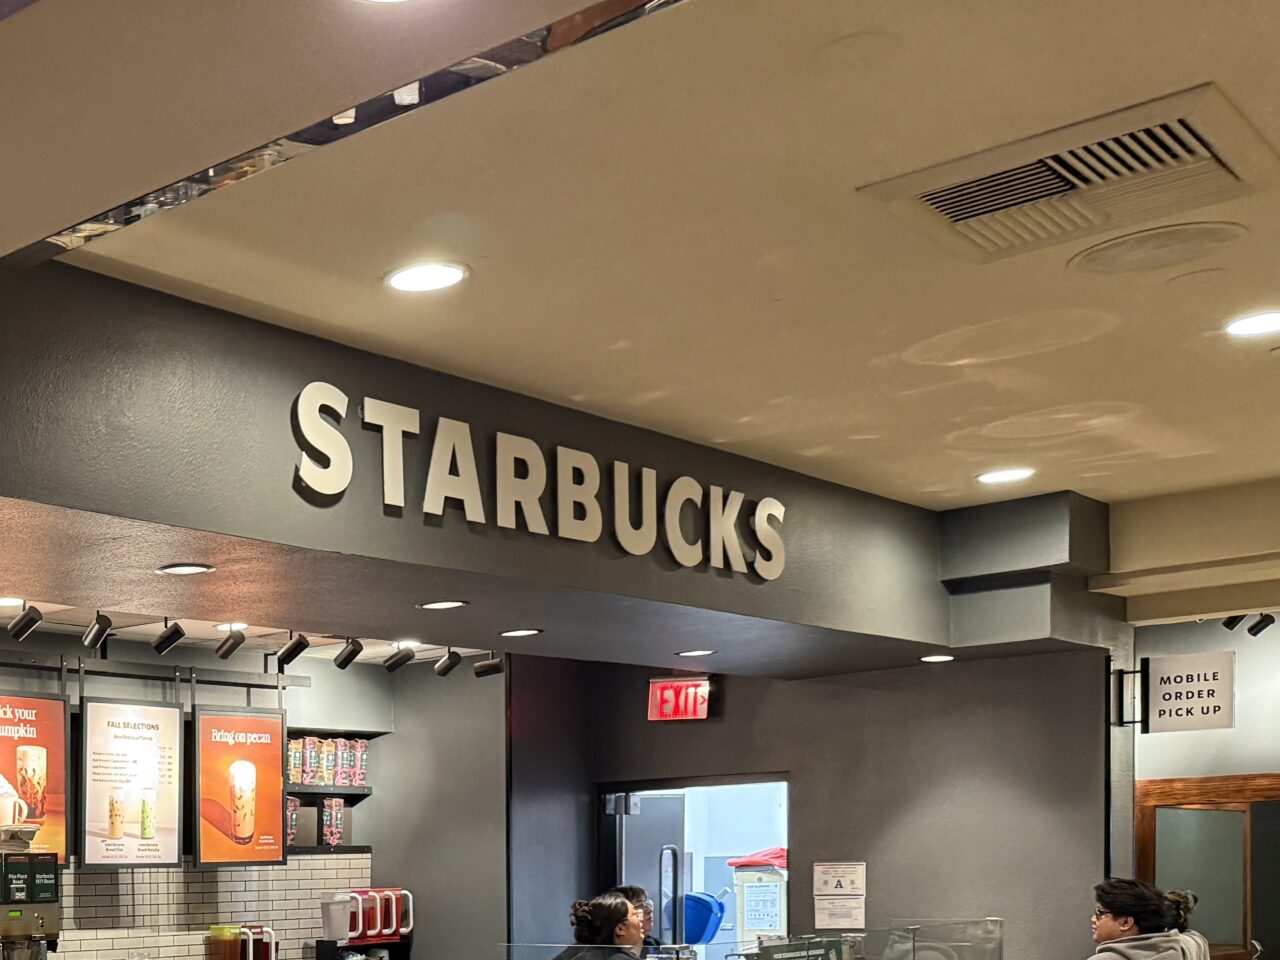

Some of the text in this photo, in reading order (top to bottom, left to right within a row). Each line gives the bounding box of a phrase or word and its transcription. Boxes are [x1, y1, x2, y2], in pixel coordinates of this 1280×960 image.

[296, 381, 786, 581] STARBUCKS
[1159, 671, 1220, 686] MOBILE
[657, 683, 702, 719] EXIT
[1162, 688, 1216, 702] ORDER
[13, 707, 37, 722] your
[1158, 705, 1222, 719] PICK UP
[106, 720, 160, 731] FALL SELECTIONS
[211, 729, 271, 746] Bring on pecan
[833, 879, 844, 889] A
